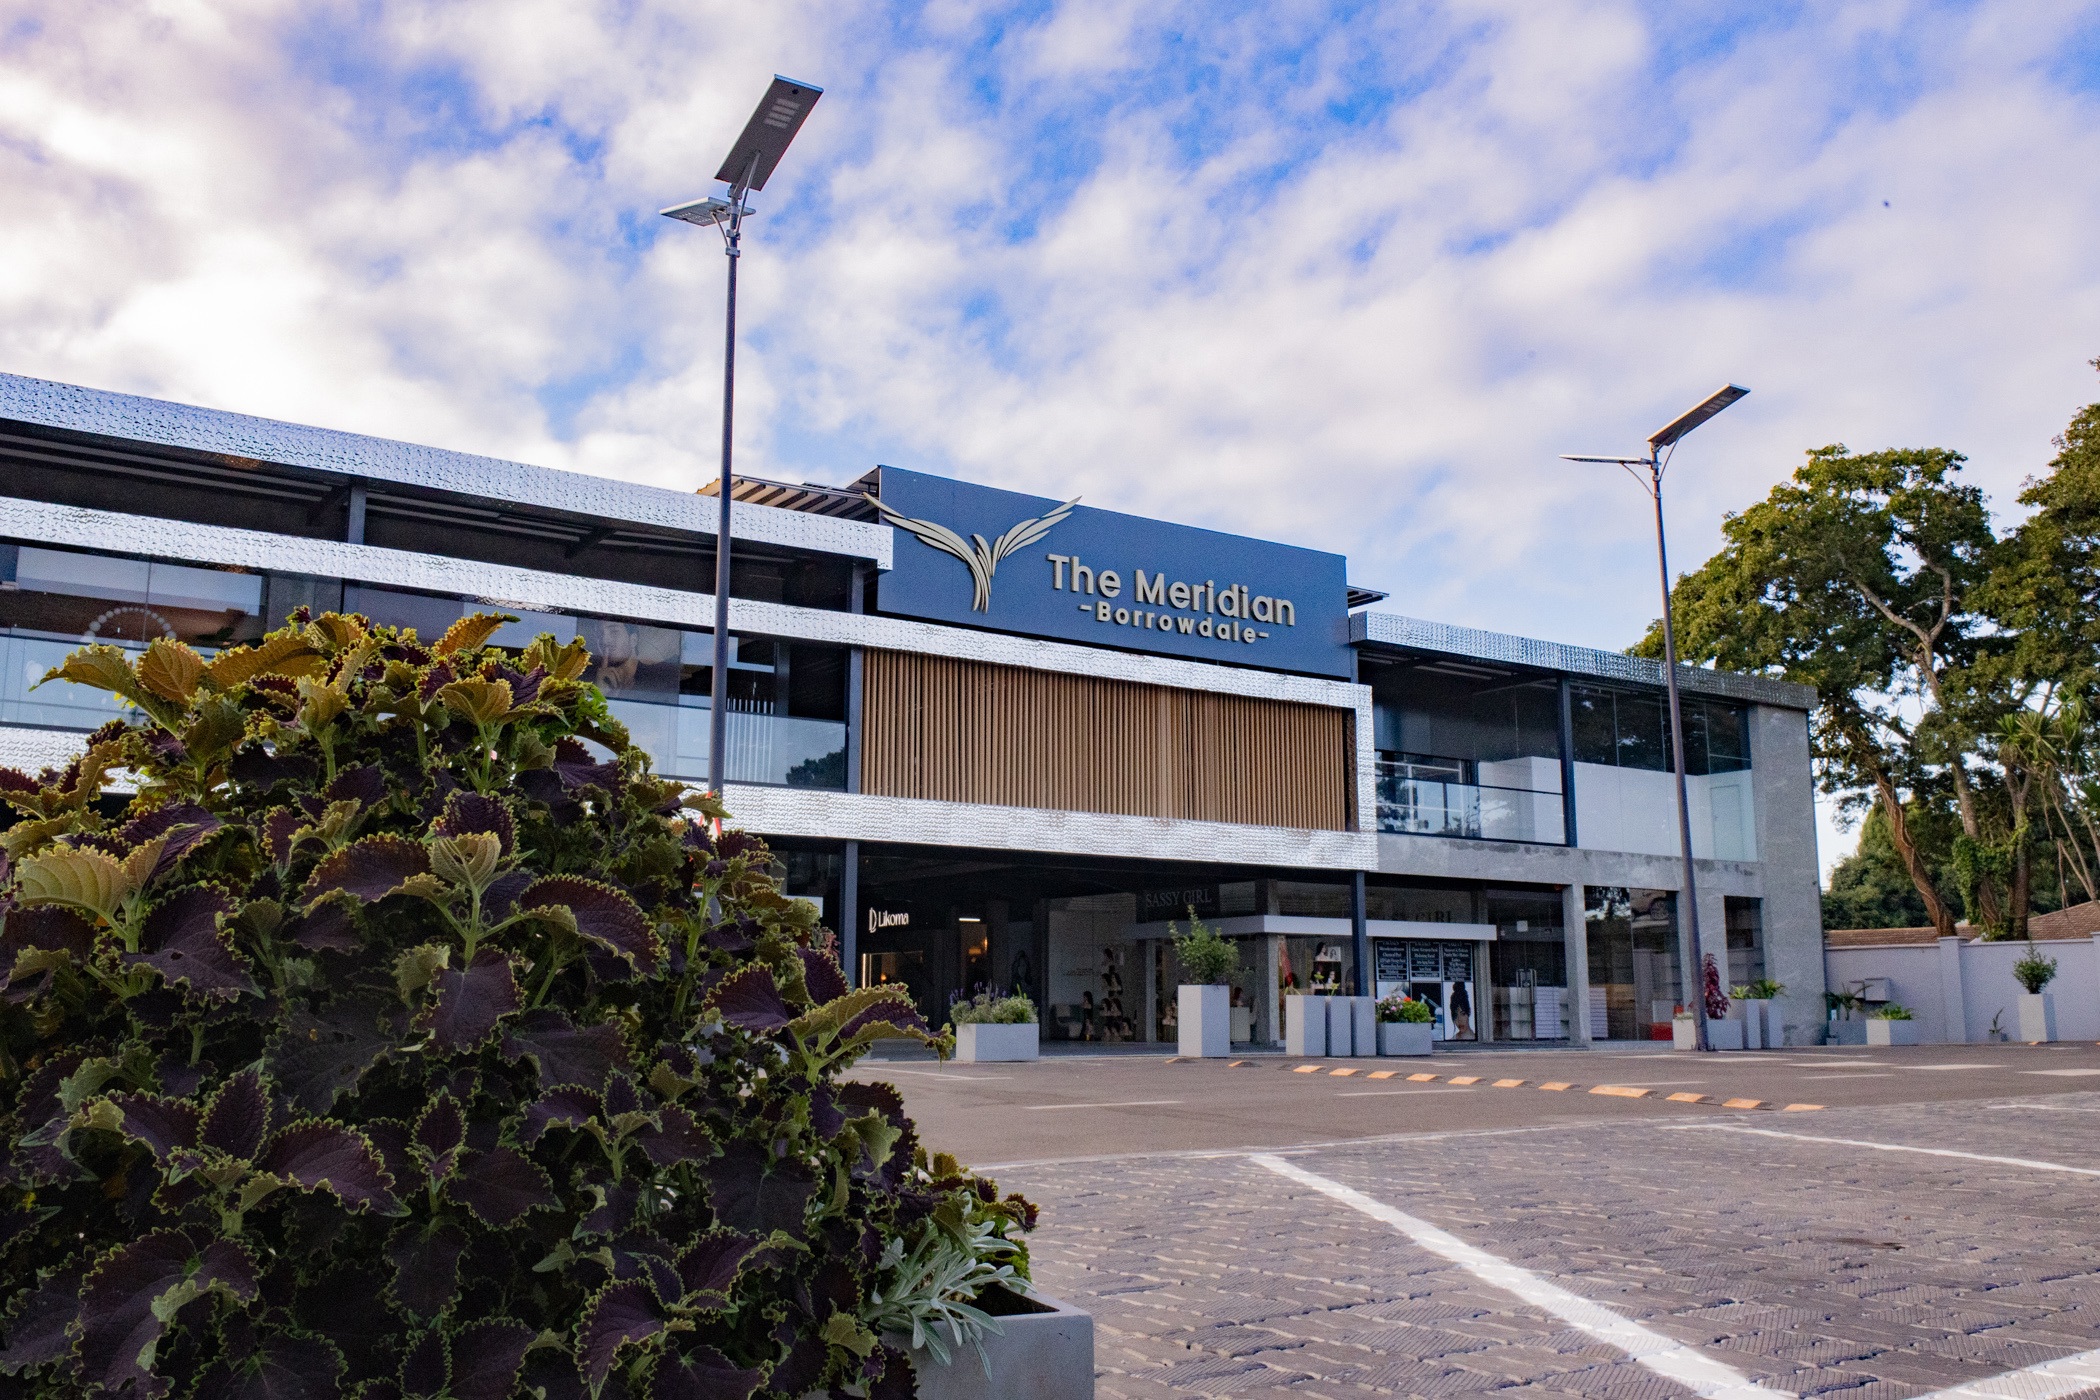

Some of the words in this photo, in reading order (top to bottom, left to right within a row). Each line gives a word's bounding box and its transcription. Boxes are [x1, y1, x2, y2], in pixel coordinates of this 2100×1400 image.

[1047, 553, 1121, 598] The
[1135, 569, 1296, 627] Meridian
[1145, 891, 1180, 908] SASSY
[1183, 888, 1213, 905] GIRL
[878, 910, 909, 927] Likoma
